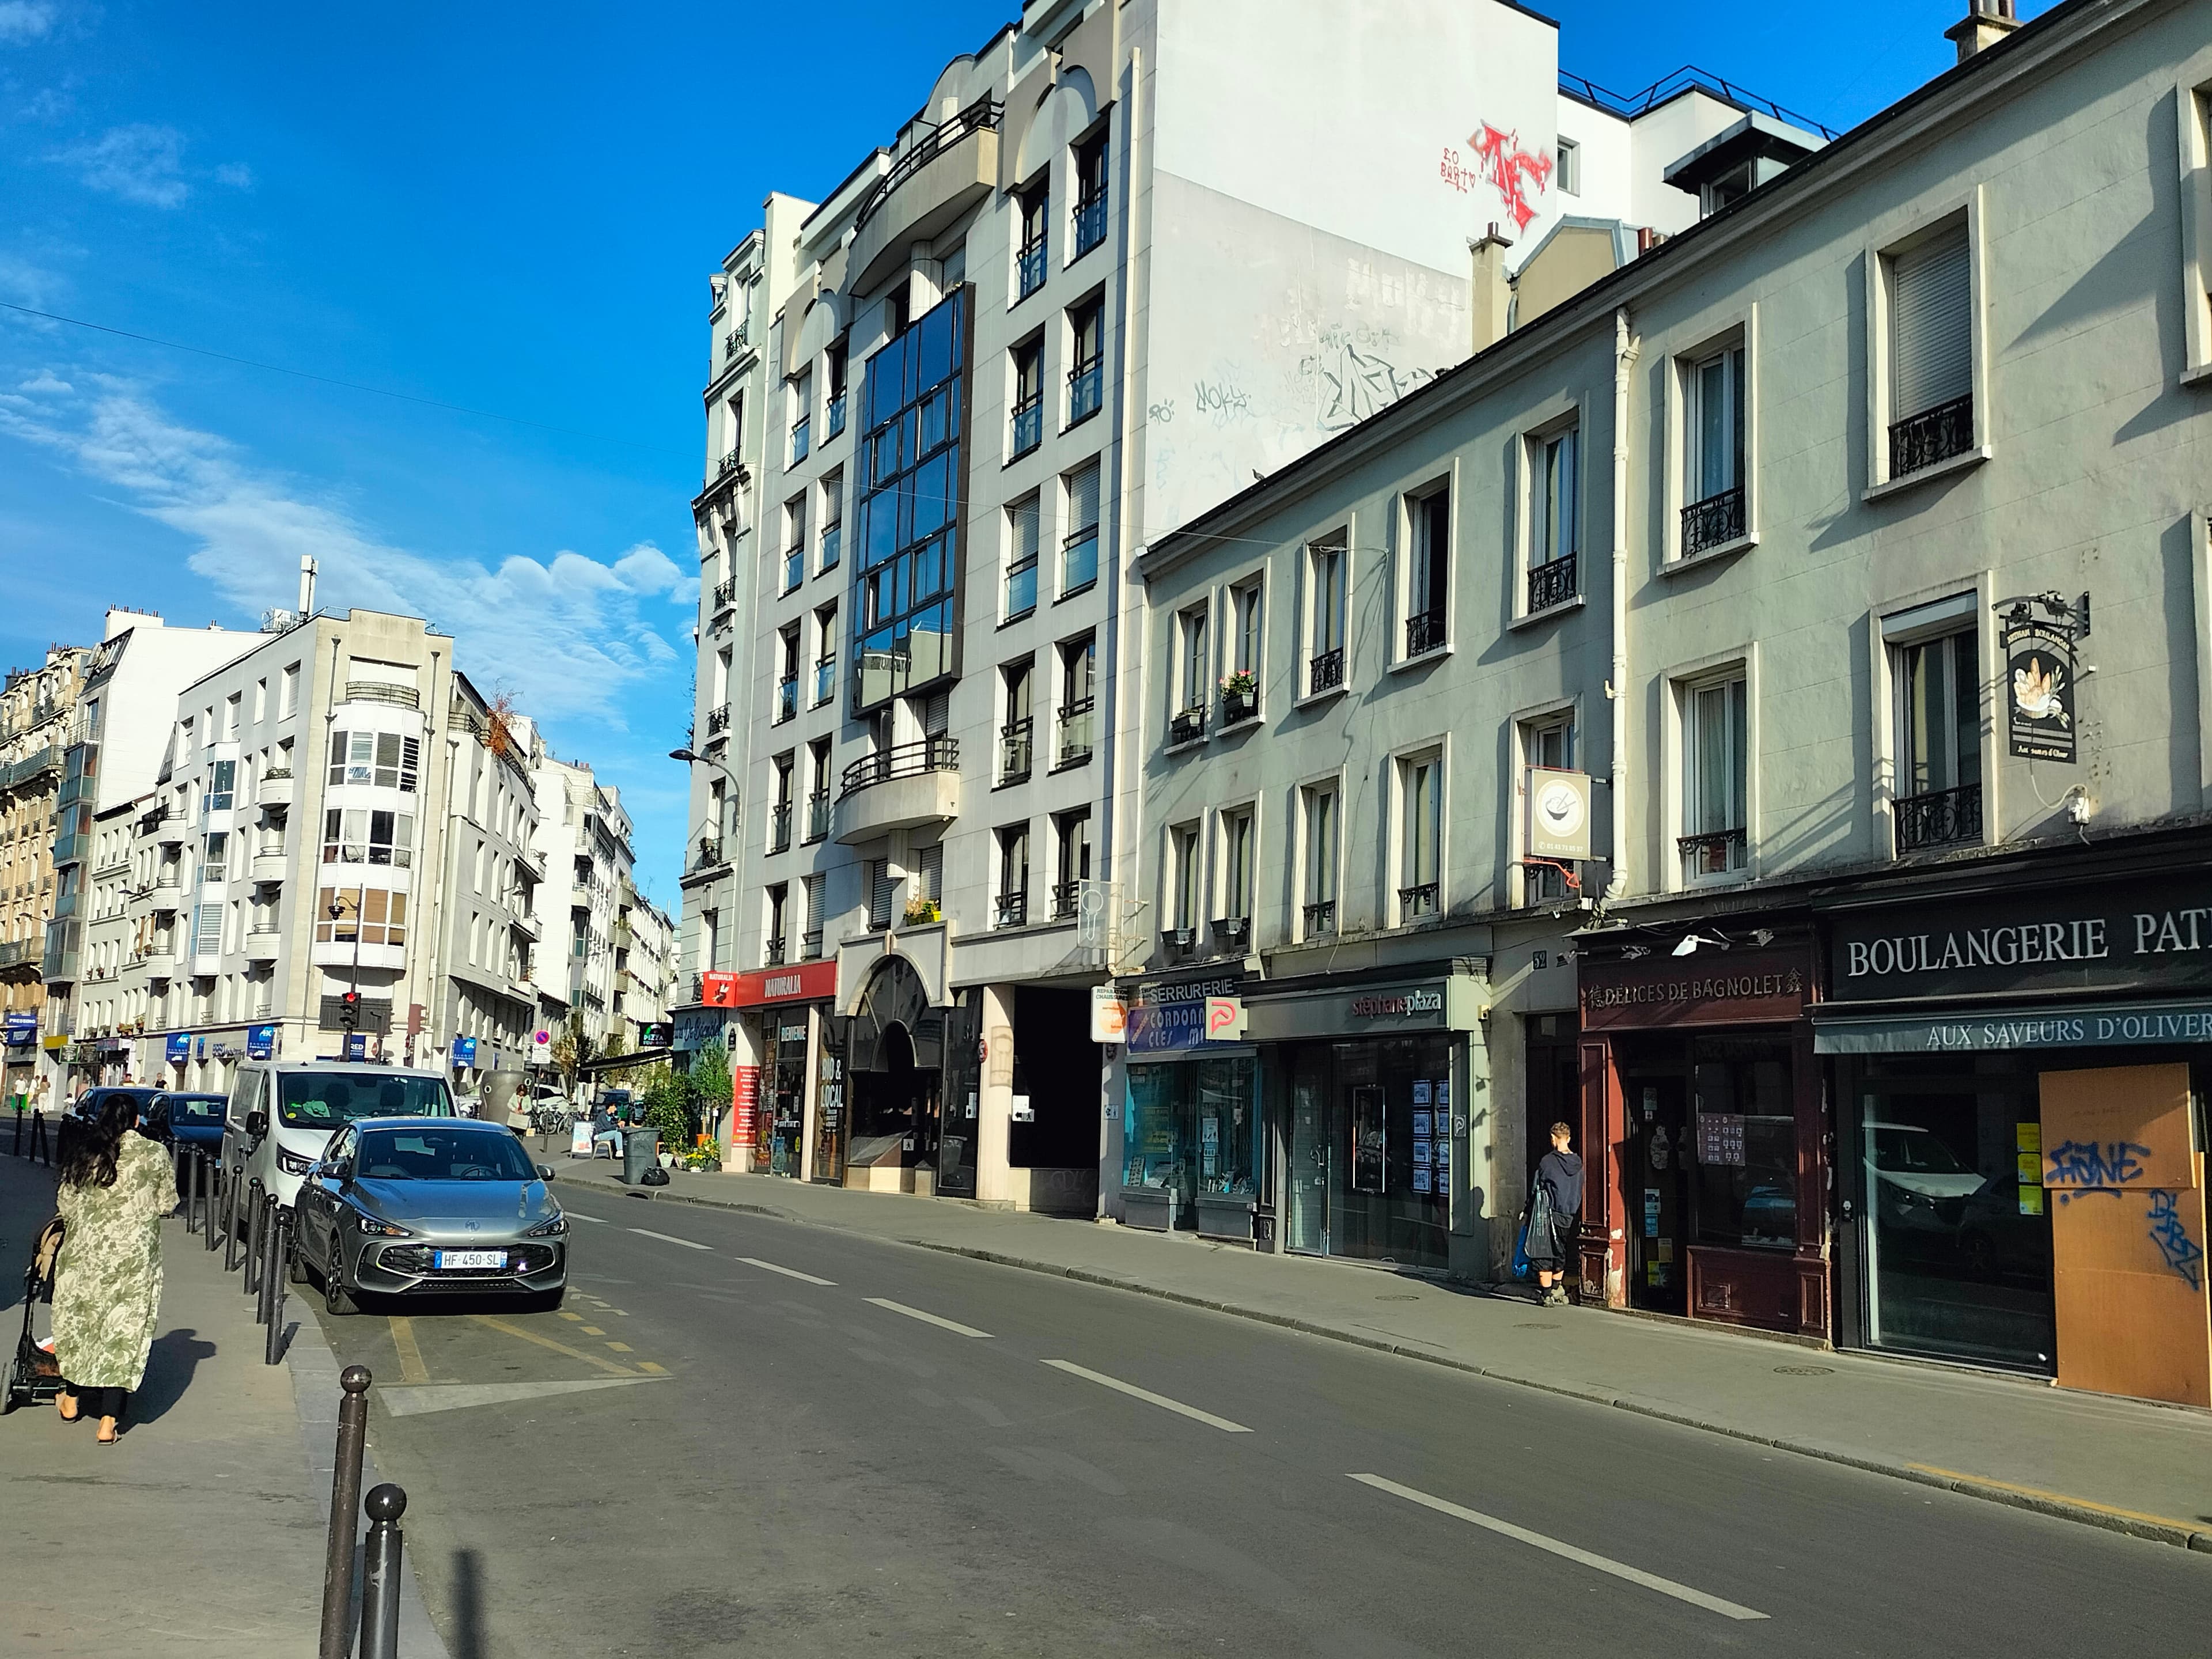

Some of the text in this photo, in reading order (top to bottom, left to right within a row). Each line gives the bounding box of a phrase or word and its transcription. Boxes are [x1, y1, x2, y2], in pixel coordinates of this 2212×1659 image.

[1847, 908, 2212, 976] BOULANGERIE PAT
[709, 973, 734, 981] NATURALIA
[764, 974, 801, 998] NATURALIA
[1669, 982, 1688, 1001] DE
[1692, 974, 1783, 999] BAGNOLET
[1150, 979, 1234, 1003] SERRURERIE
[1150, 1007, 1205, 1029] CORDONN
[1926, 1025, 1973, 1047] AUX
[1984, 1020, 2084, 1046] SAVEURS
[821, 1057, 842, 1081] BIO &
[820, 1085, 843, 1107] LOCAL
